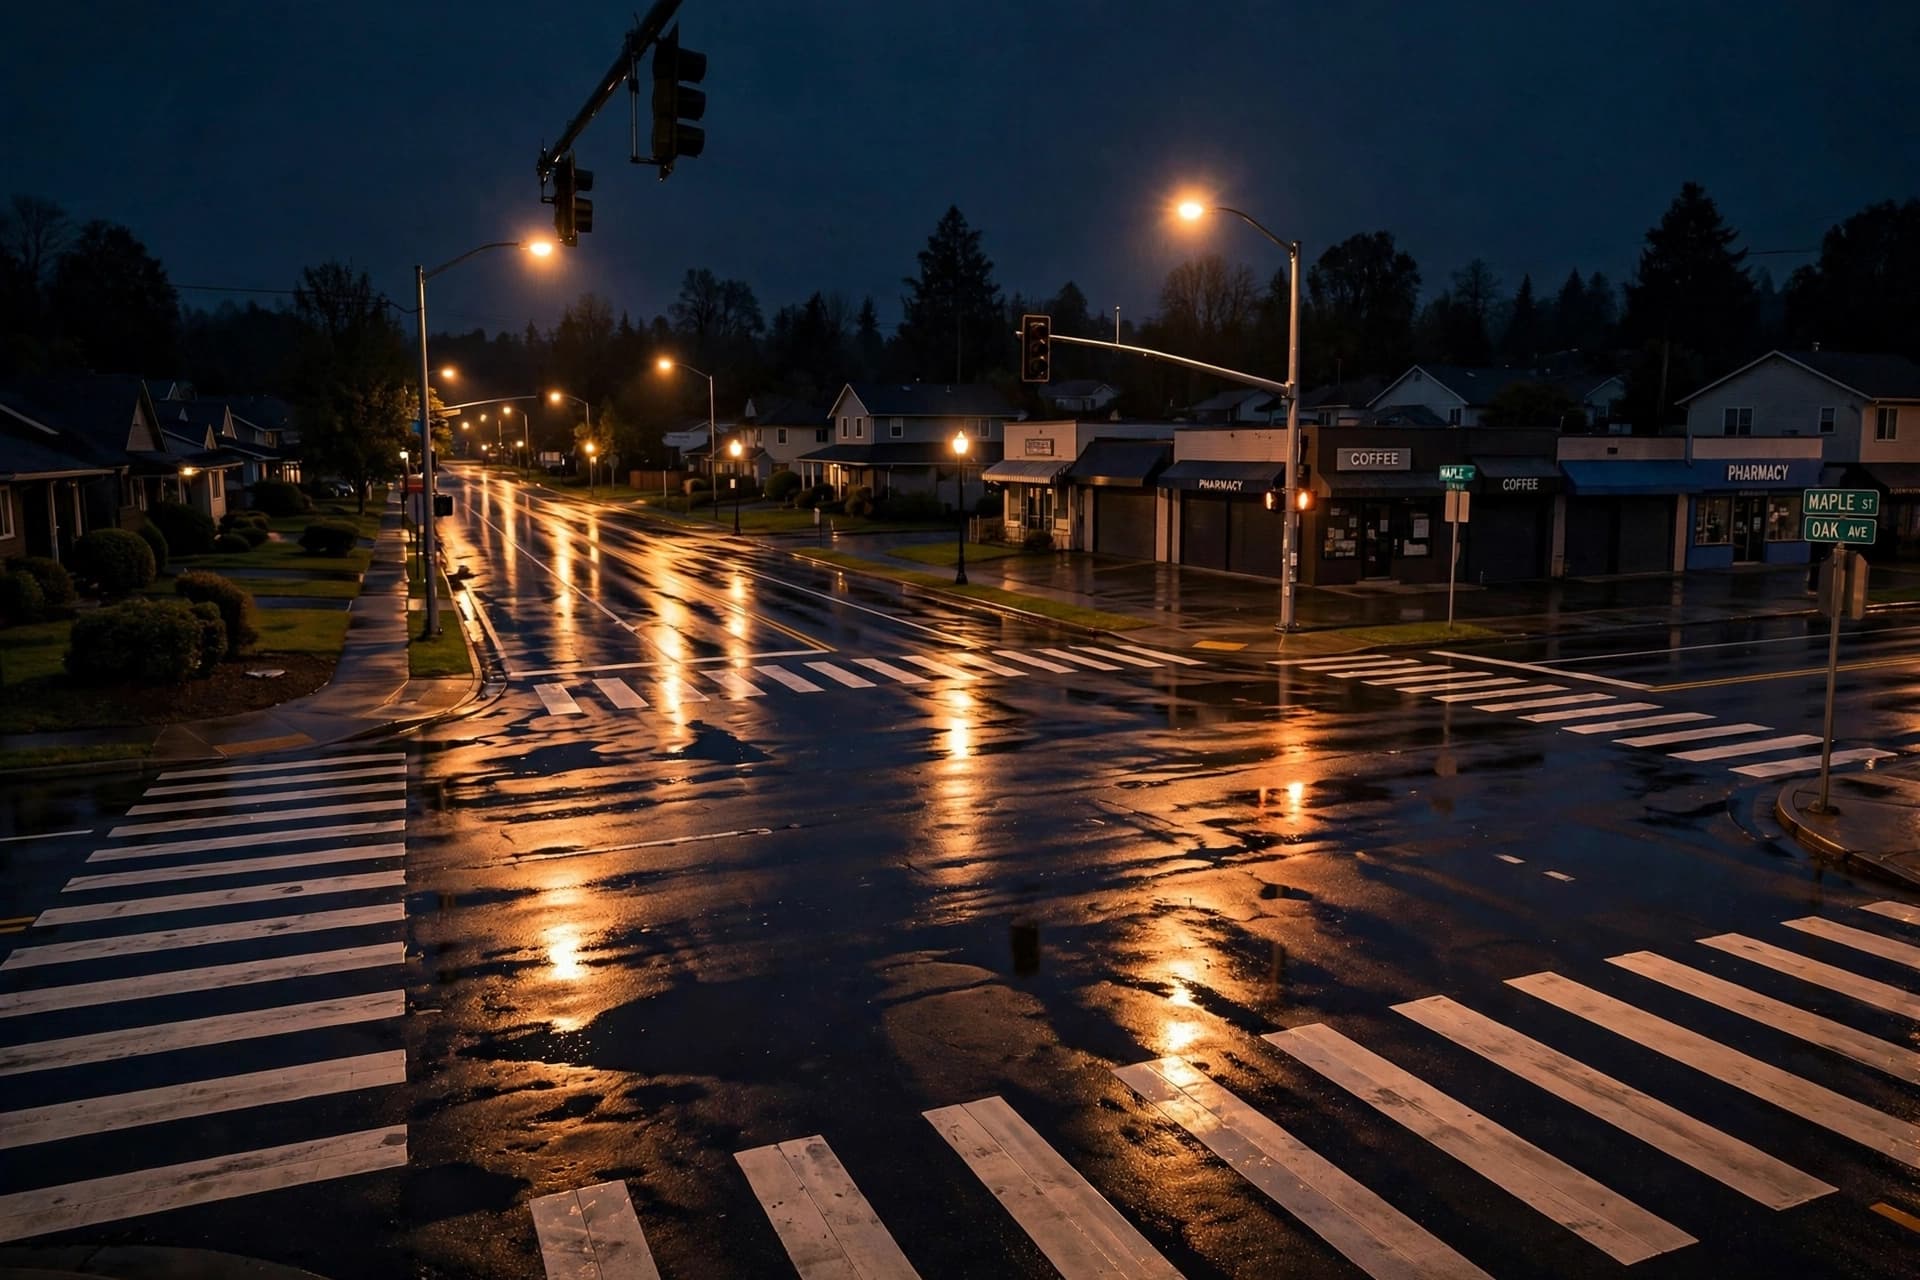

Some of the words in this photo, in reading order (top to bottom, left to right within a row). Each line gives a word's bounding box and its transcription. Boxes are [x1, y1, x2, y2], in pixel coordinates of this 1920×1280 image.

[1351, 452, 1399, 465] COFFEE
[1728, 464, 1789, 481] PHARMACY
[1199, 478, 1243, 491] PHARMACY
[1502, 478, 1539, 491] COFFEE
[1808, 493, 1855, 511] MAPLE
[1861, 498, 1873, 510] ST
[1812, 521, 1839, 539] OAK
[1848, 525, 1868, 538] AVE
